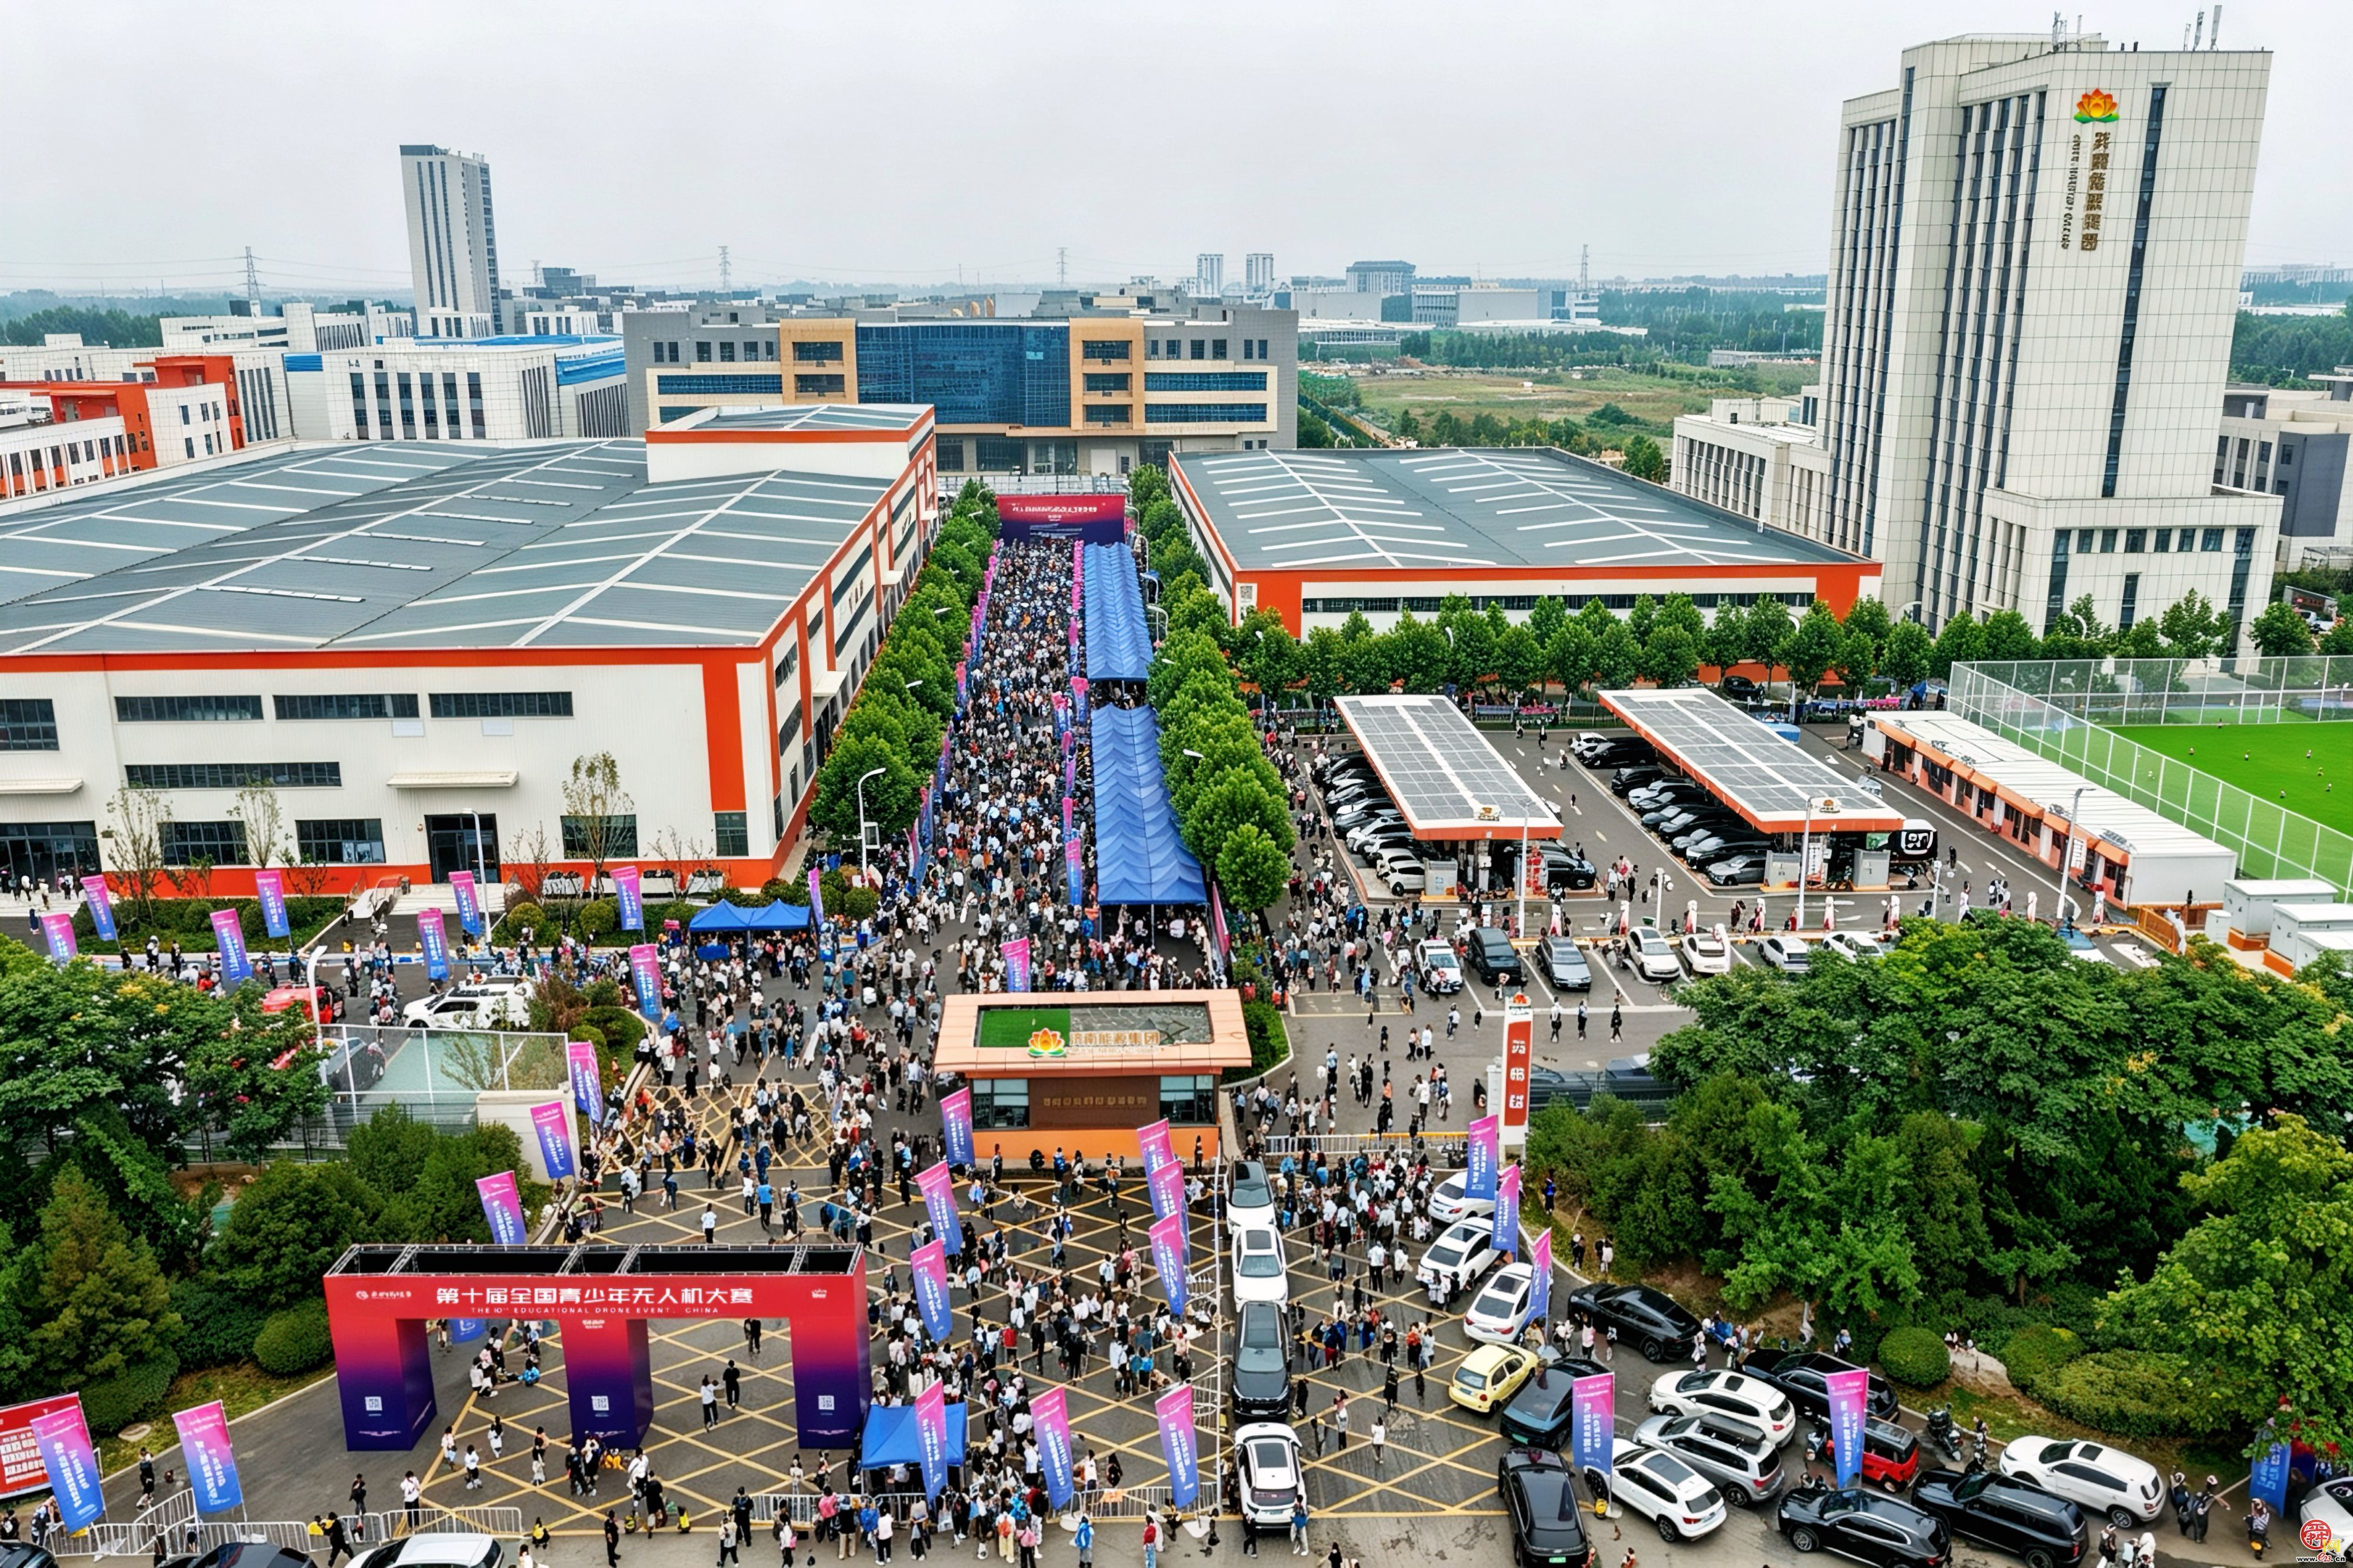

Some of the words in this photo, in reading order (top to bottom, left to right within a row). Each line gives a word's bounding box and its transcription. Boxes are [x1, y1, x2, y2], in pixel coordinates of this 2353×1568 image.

[436, 1287, 753, 1304] 第十届全国青少年无人机大赛
